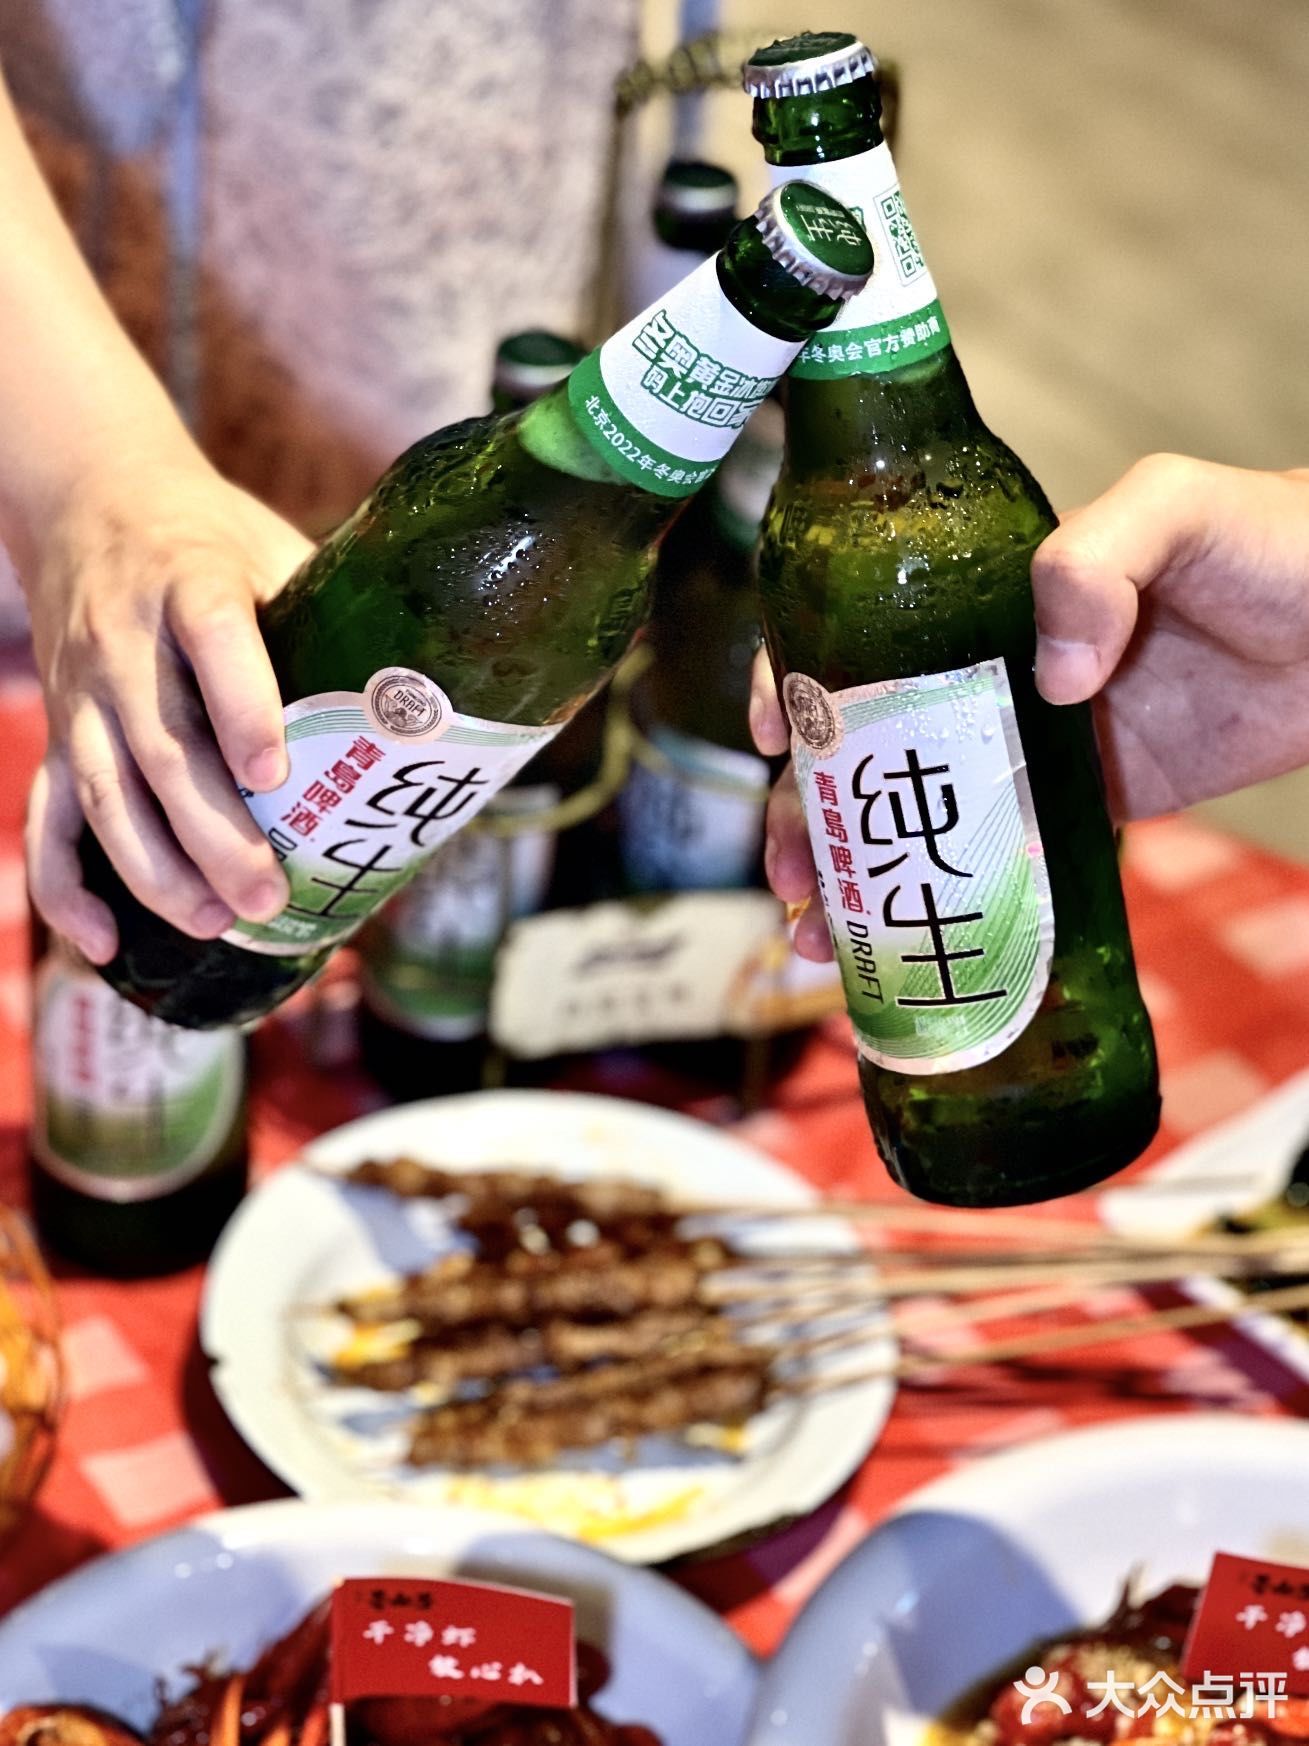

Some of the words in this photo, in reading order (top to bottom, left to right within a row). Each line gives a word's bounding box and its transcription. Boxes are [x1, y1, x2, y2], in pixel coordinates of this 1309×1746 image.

[394, 690, 426, 717] DRAFT
[288, 760, 490, 918] 纯生
[852, 749, 1008, 1006] 纯生
[846, 920, 884, 1004] DRAFT
